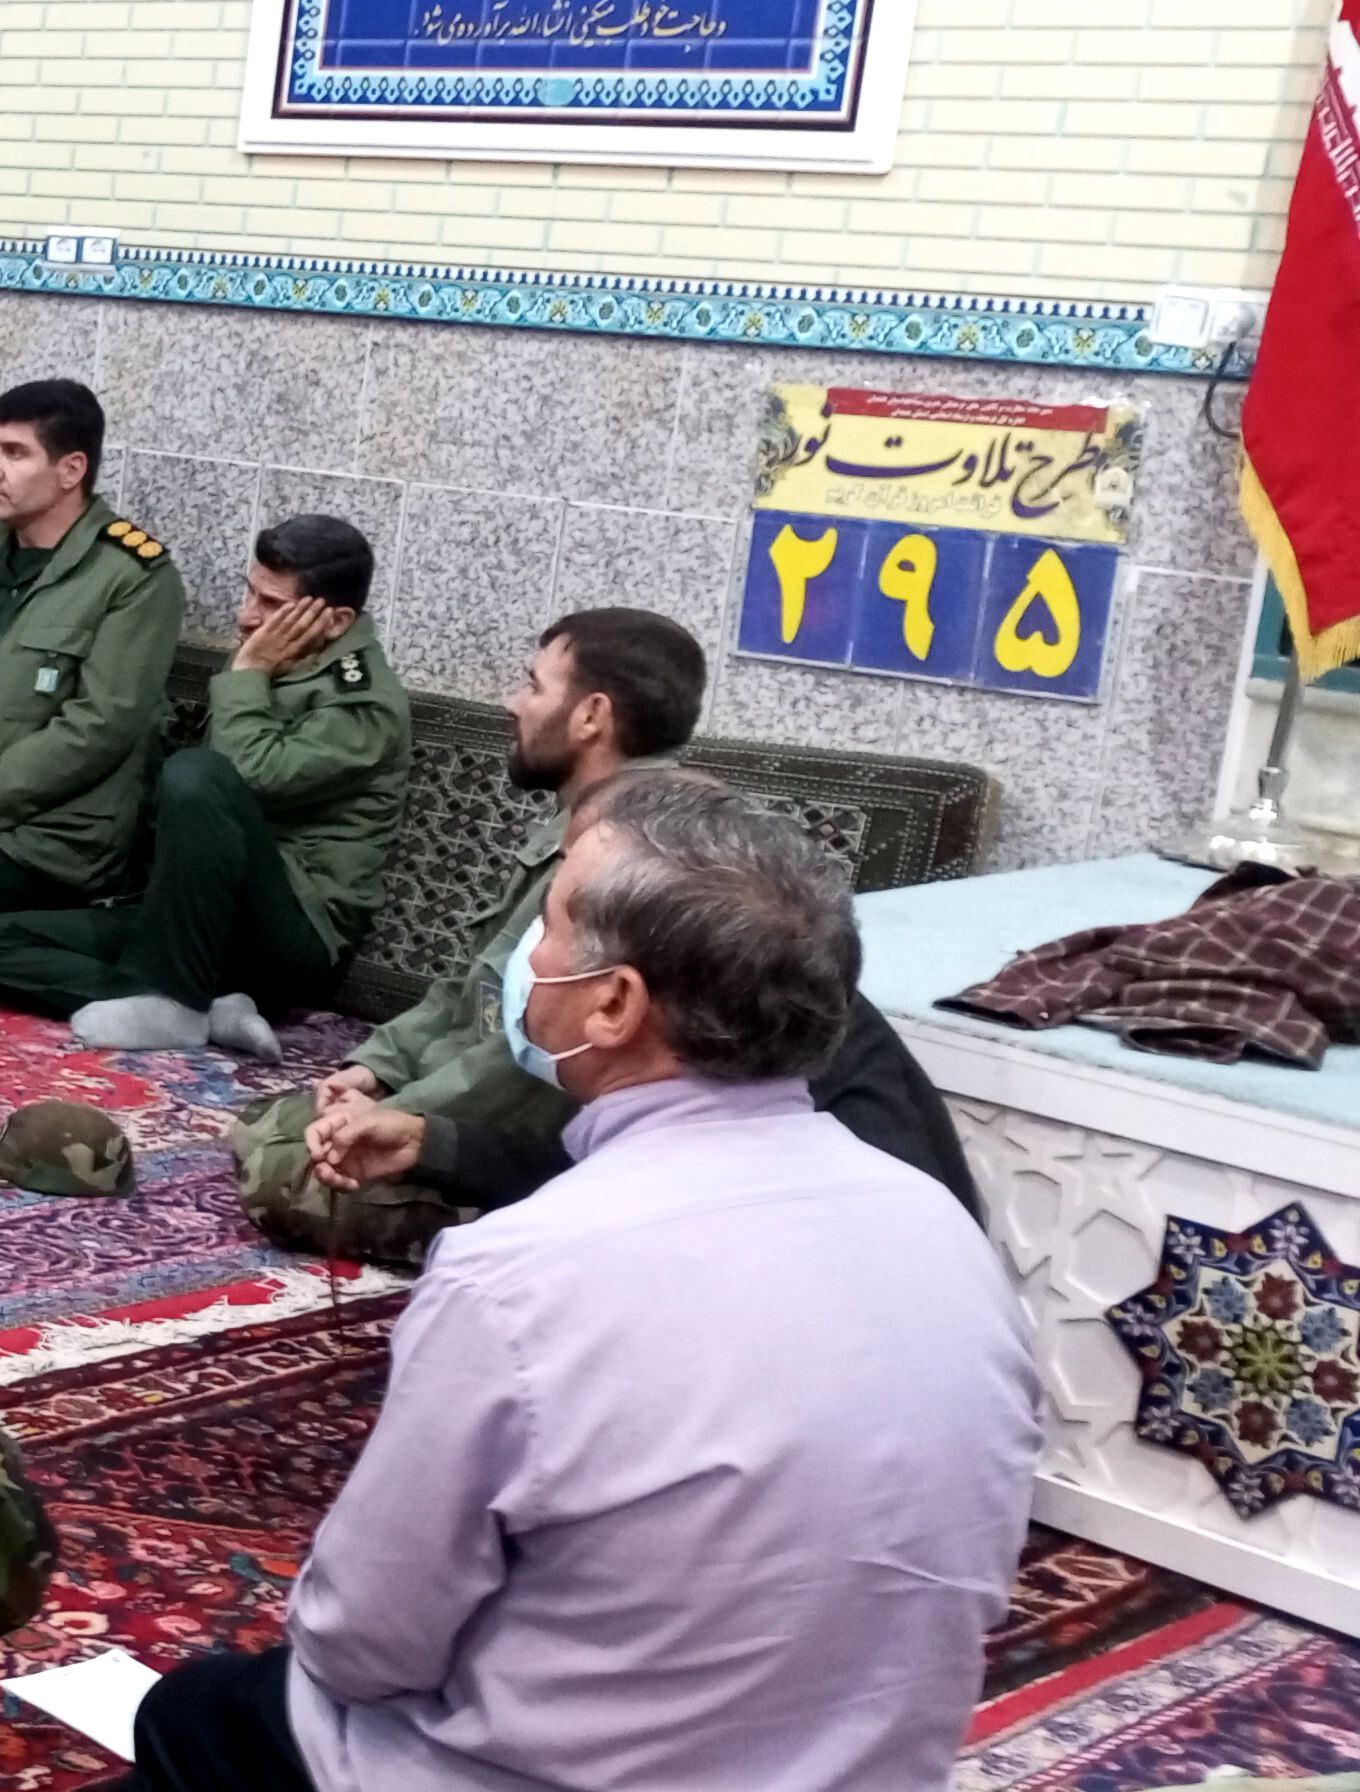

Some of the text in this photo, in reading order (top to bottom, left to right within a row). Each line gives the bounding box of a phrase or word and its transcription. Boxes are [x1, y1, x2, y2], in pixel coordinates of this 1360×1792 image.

[766, 401, 1105, 519] طرح تلاوت نور
